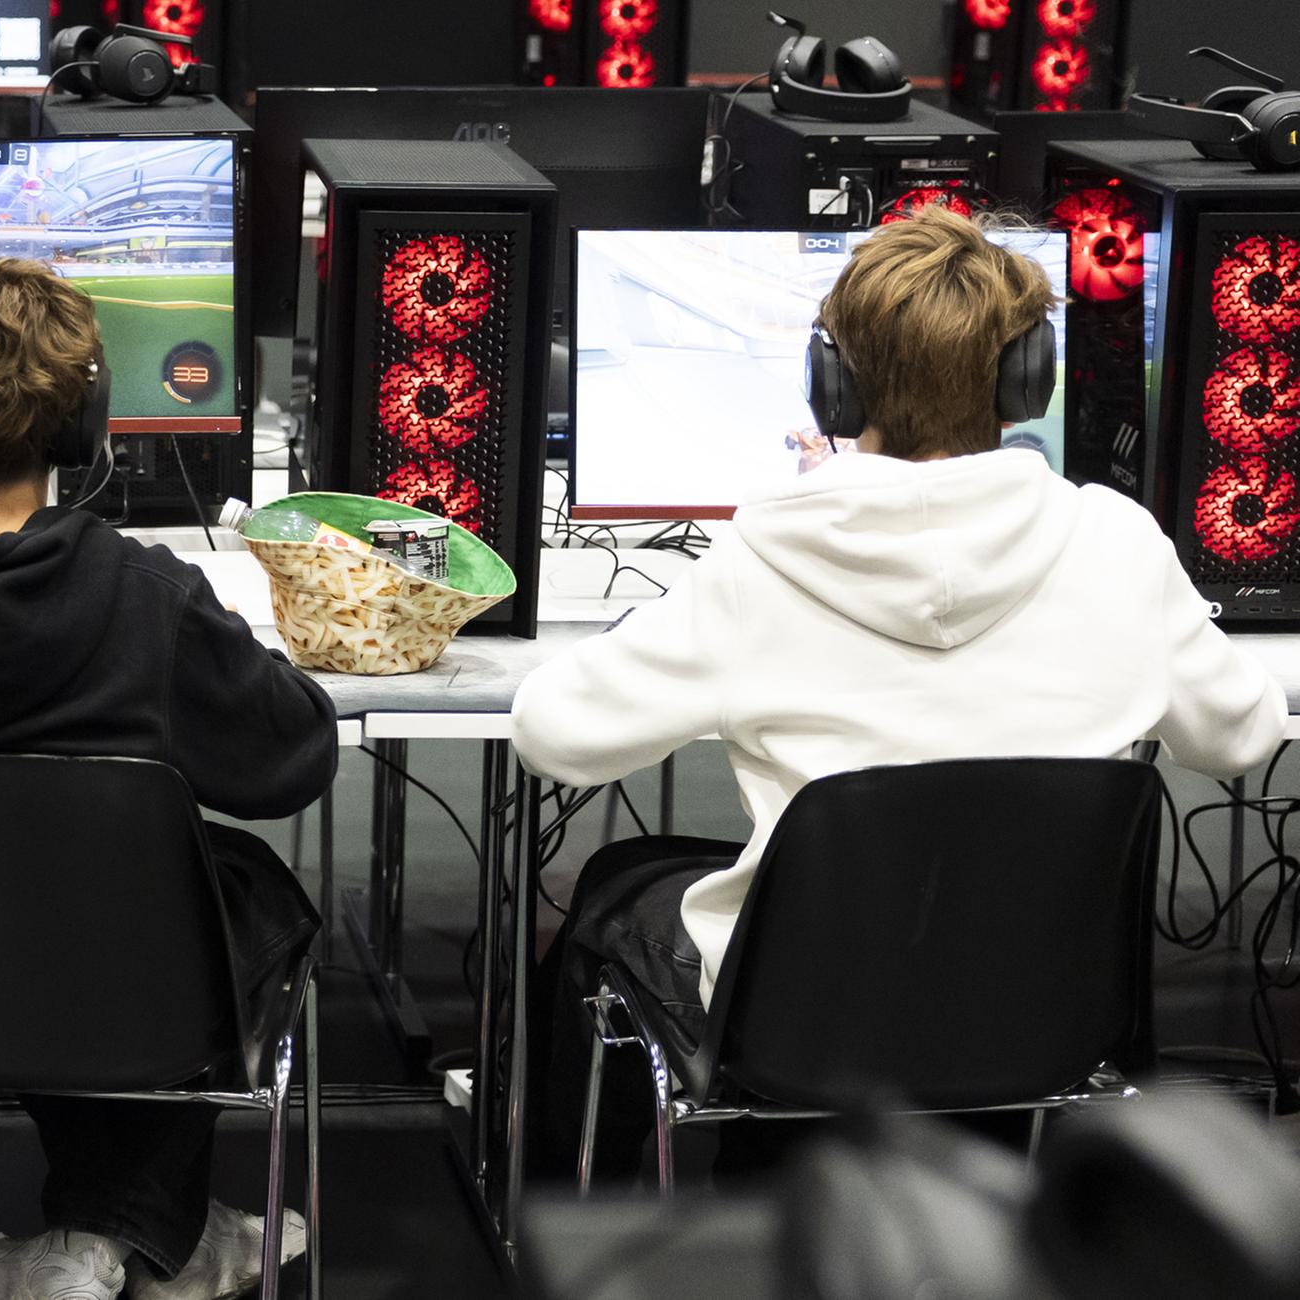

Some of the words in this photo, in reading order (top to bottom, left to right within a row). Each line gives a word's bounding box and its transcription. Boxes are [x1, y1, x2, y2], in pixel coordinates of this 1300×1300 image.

[15, 149, 27, 161] 8
[806, 239, 839, 248] 0:04
[173, 367, 208, 382] 33
